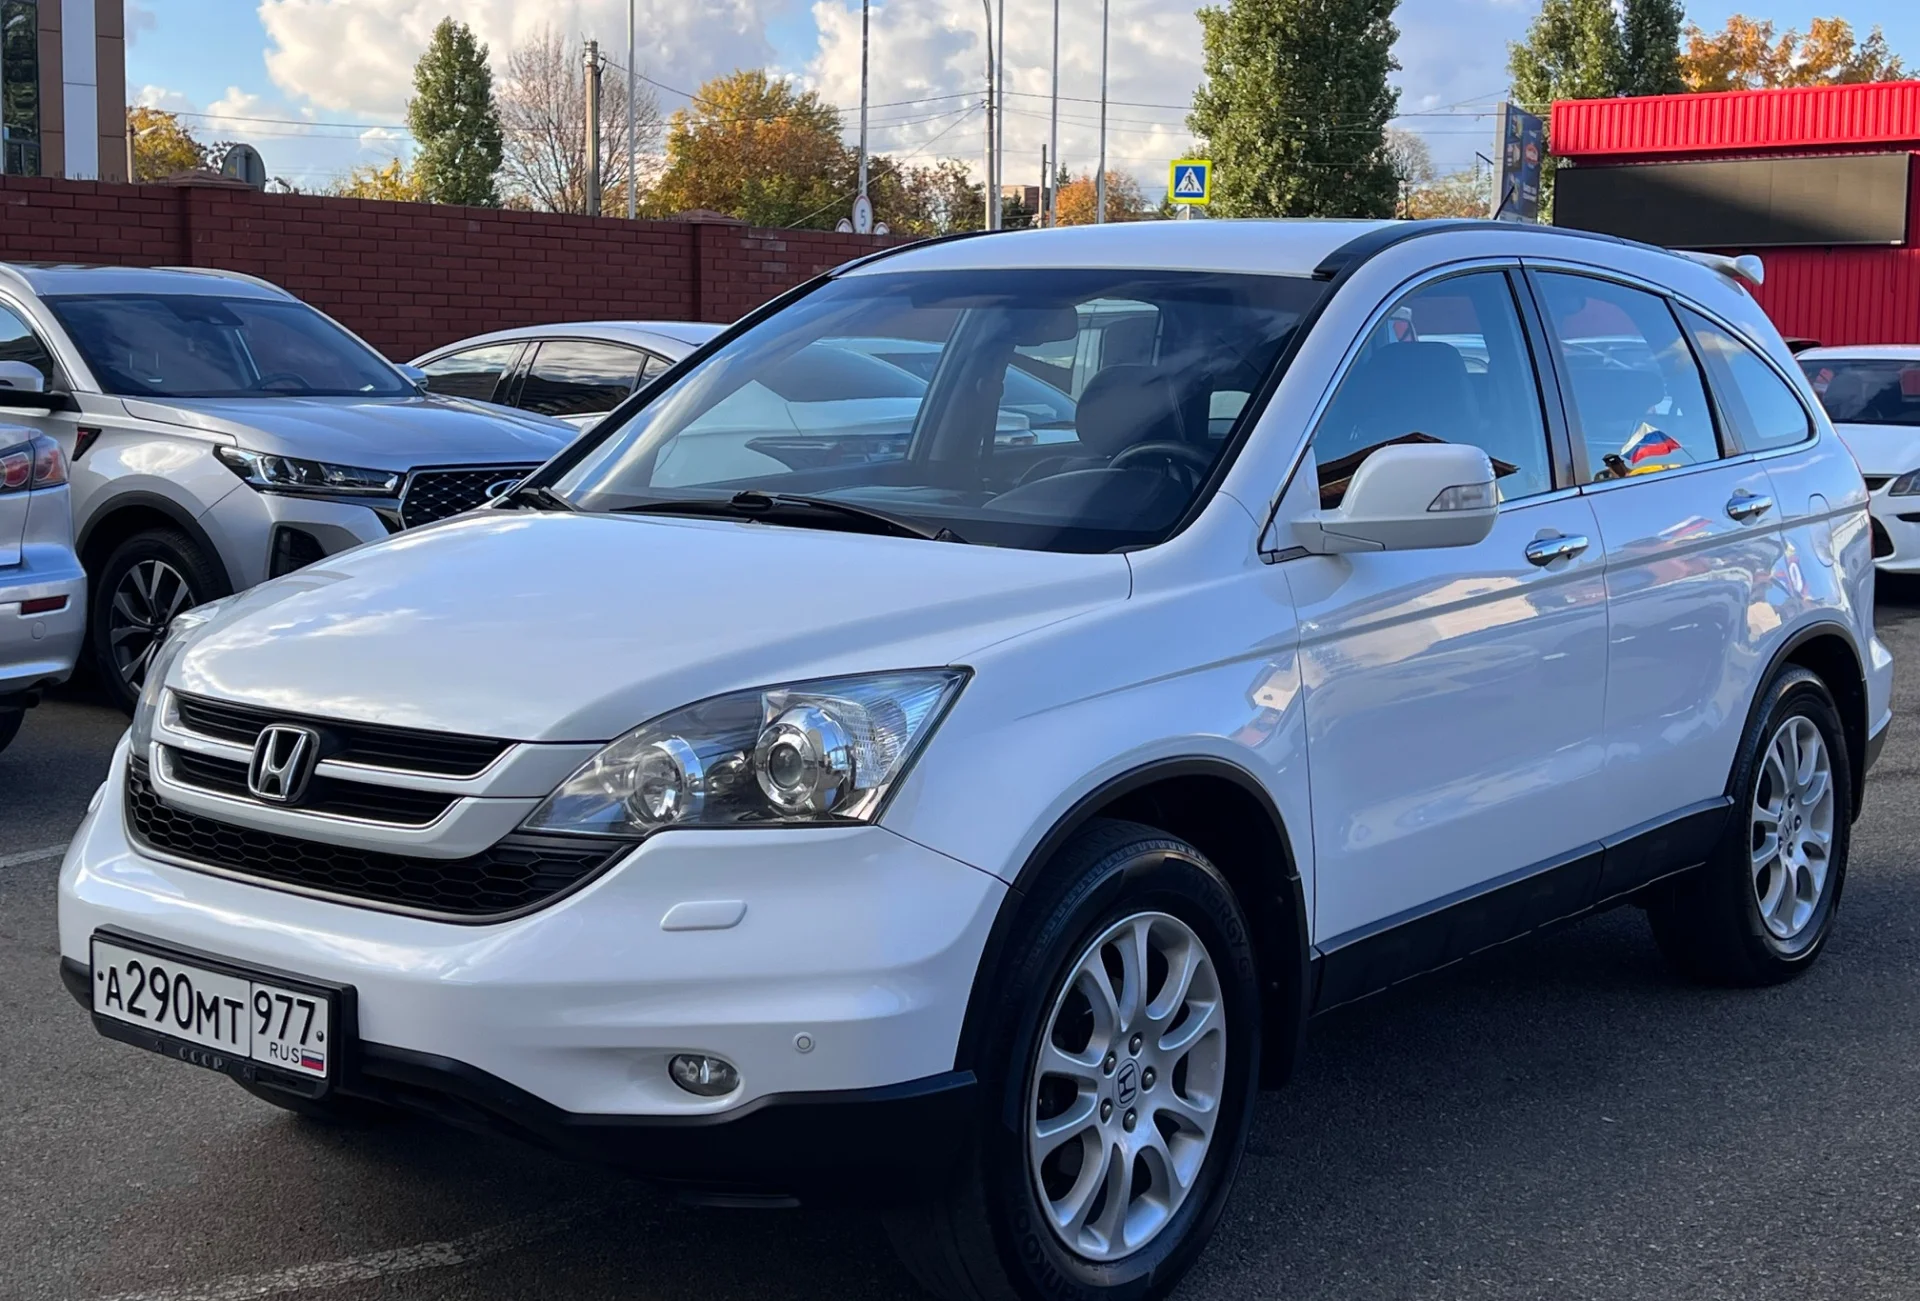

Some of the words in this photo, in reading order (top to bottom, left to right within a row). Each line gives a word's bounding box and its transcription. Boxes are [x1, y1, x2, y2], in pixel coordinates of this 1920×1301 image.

[860, 209, 867, 227] 5
[105, 959, 244, 1045] А290МТ
[254, 989, 316, 1046] 977
[270, 1041, 300, 1064] RUS
